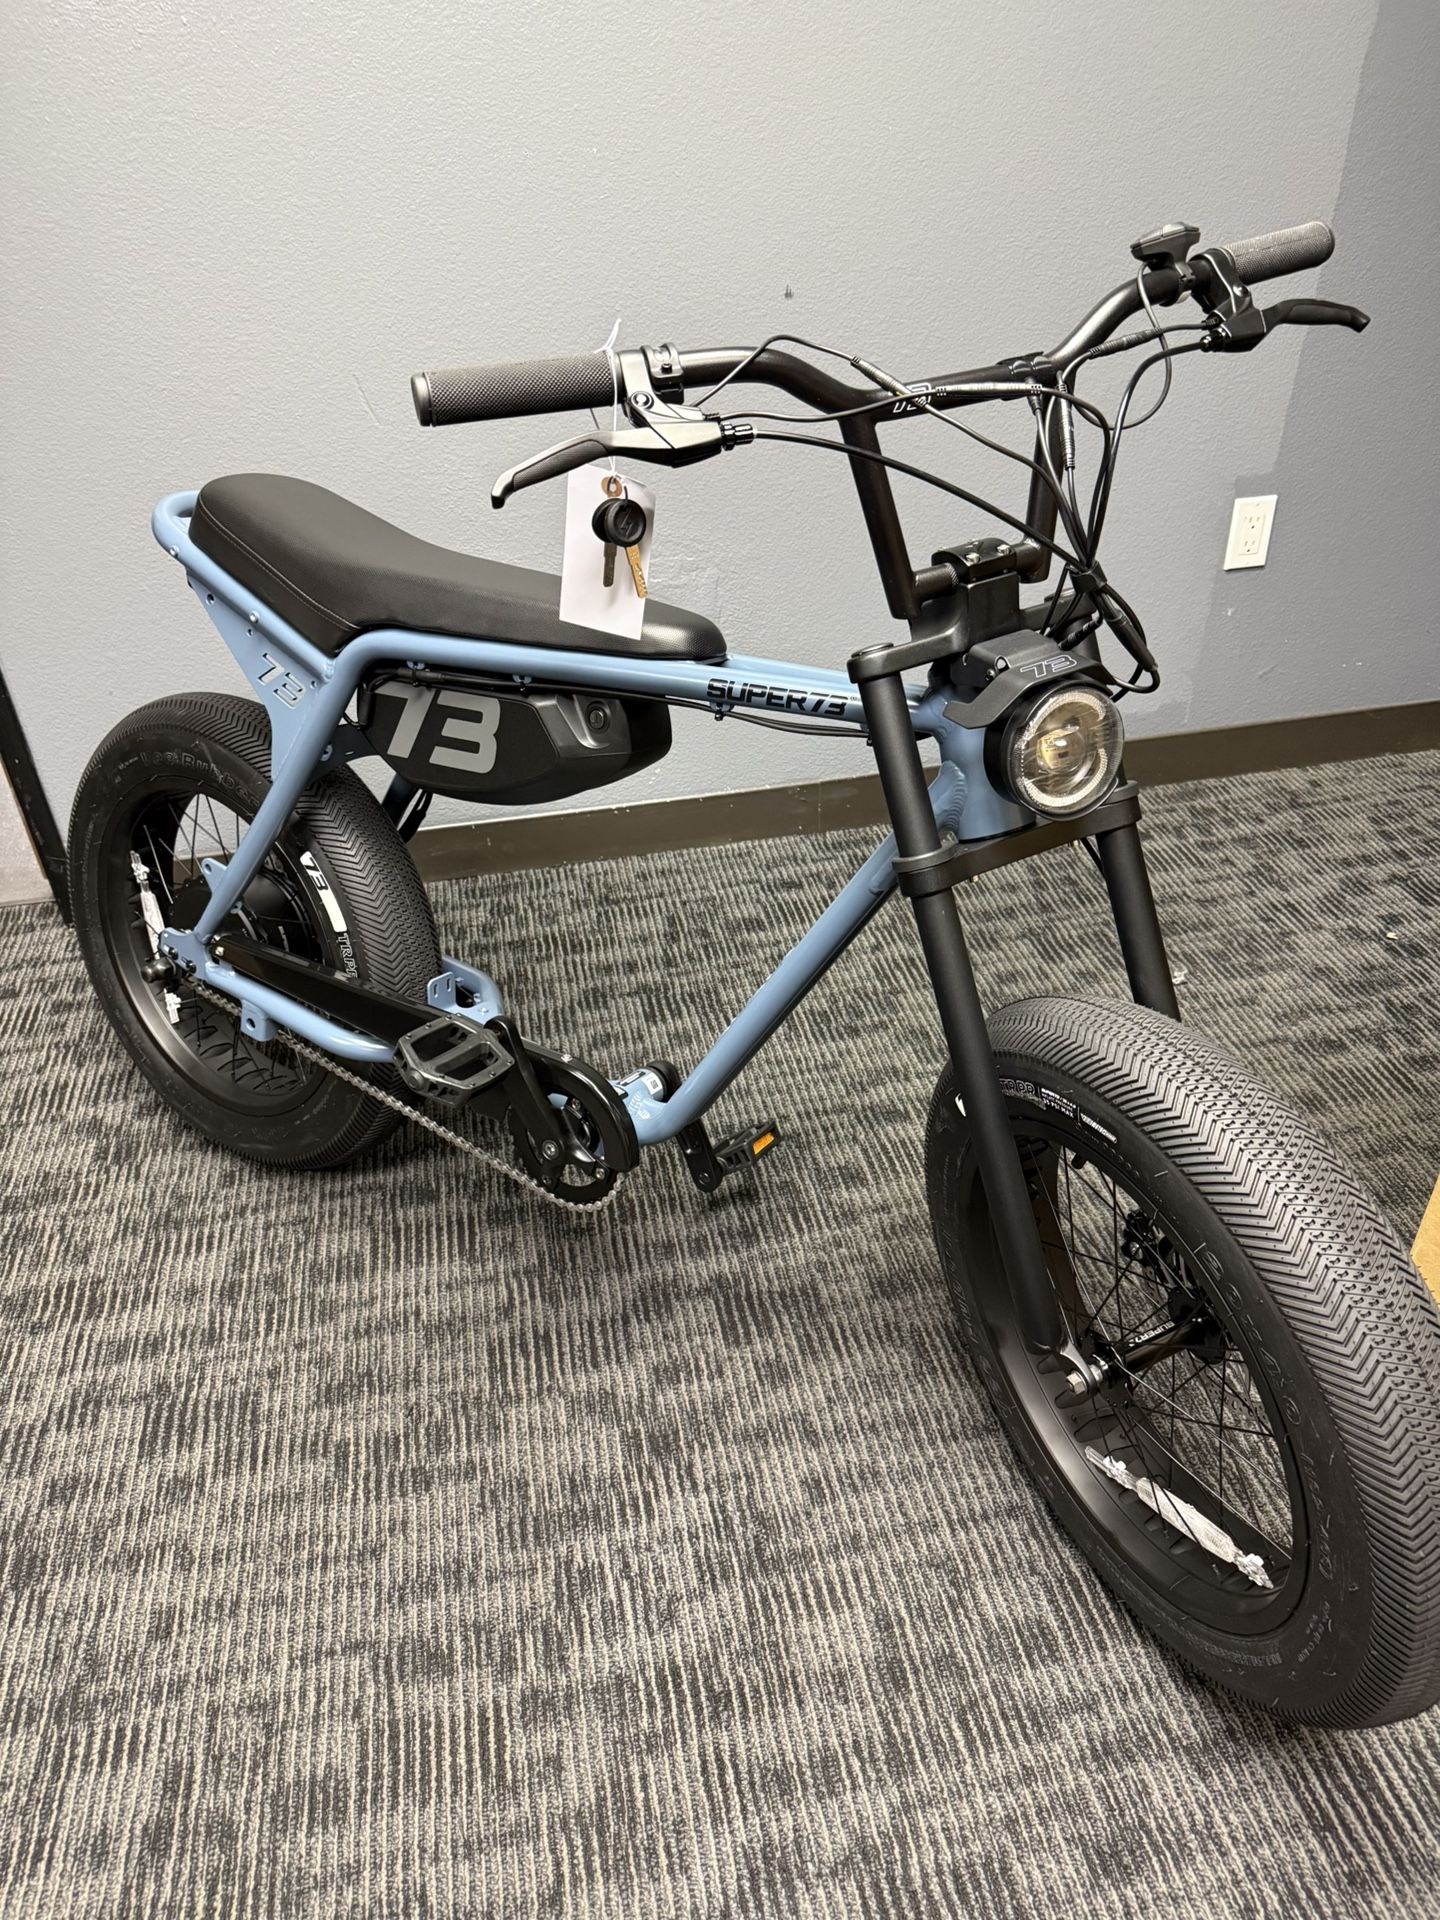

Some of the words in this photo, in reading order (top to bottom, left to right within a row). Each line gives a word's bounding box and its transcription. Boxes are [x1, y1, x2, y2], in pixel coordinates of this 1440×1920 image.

[257, 652, 306, 709] 73
[1019, 654, 1078, 678] 73
[706, 678, 848, 716] SUPER73
[374, 681, 501, 774] 73
[302, 855, 329, 891] 73
